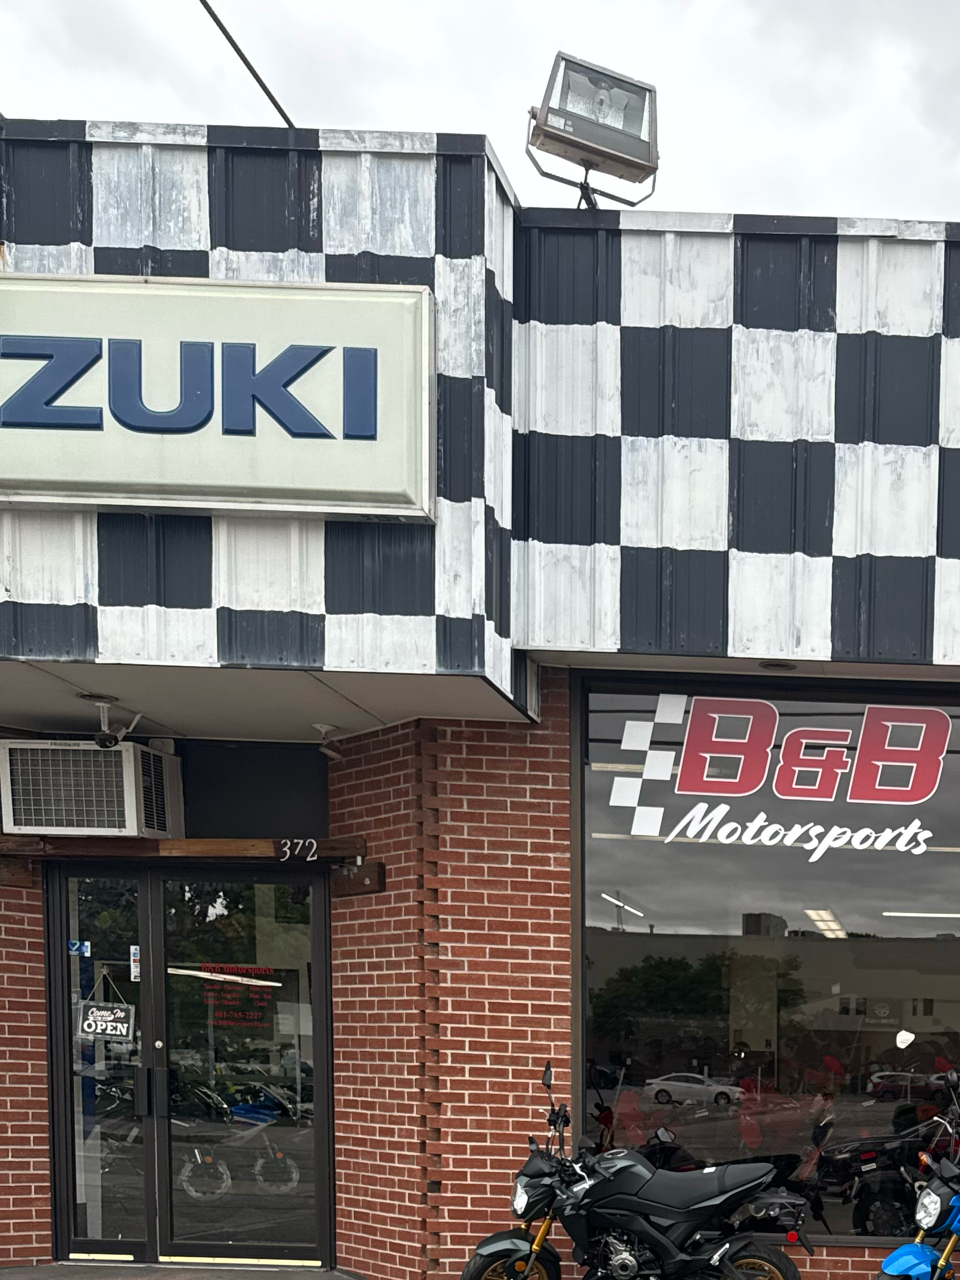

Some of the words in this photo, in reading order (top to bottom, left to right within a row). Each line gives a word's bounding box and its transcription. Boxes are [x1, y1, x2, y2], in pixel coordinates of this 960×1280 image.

[0, 334, 378, 441] ZUKI
[674, 696, 952, 805] B&B
[665, 801, 934, 863] Motorsports
[280, 838, 318, 862] 372
[222, 963, 274, 977] Motorsports
[88, 1007, 112, 1018] Come
[113, 1008, 126, 1019] In
[83, 1020, 128, 1036] OPEN
